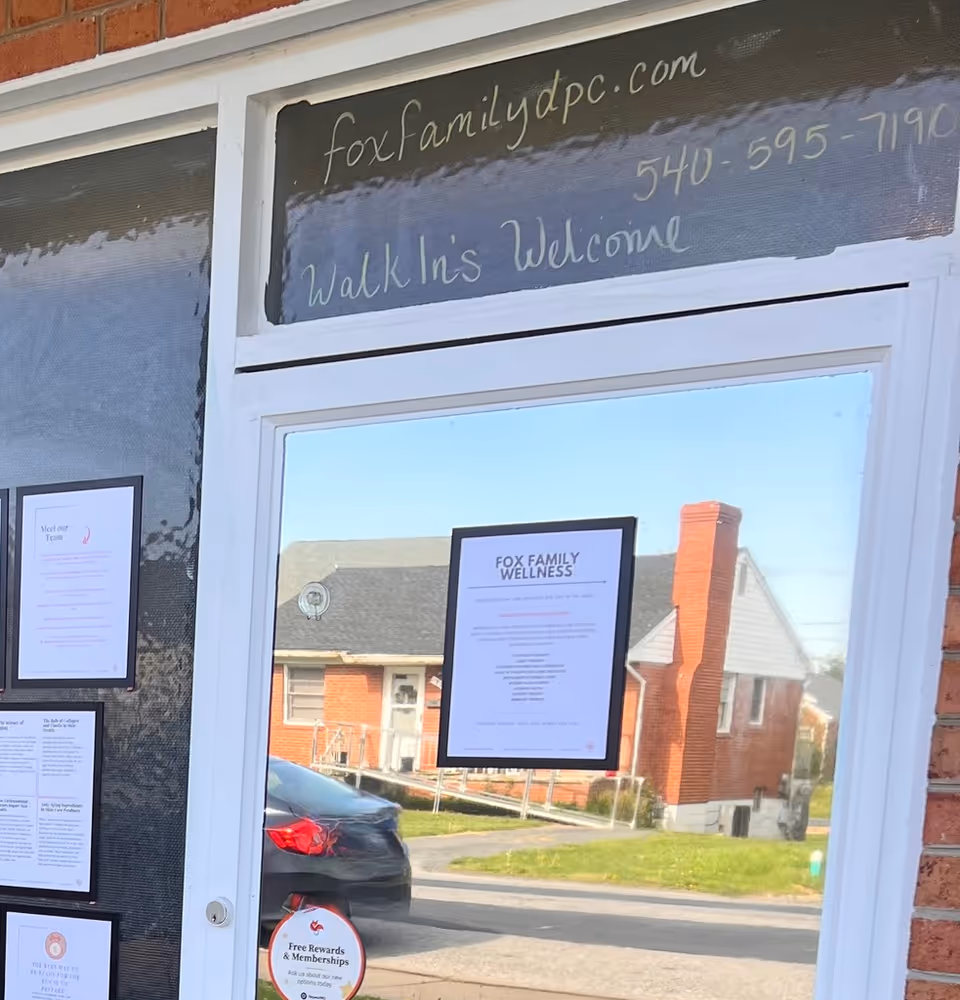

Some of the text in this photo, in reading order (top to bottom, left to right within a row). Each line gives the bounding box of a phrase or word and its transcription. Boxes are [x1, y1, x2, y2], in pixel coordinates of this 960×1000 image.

[323, 50, 706, 185] foxfamilydpc.com
[302, 256, 408, 307] Walk
[500, 214, 692, 272] Welcome
[495, 551, 580, 569] FOX FAMILY
[500, 564, 574, 581] WELLNESS
[288, 942, 345, 955] Free Rewards
[282, 952, 349, 967] & Memberships
